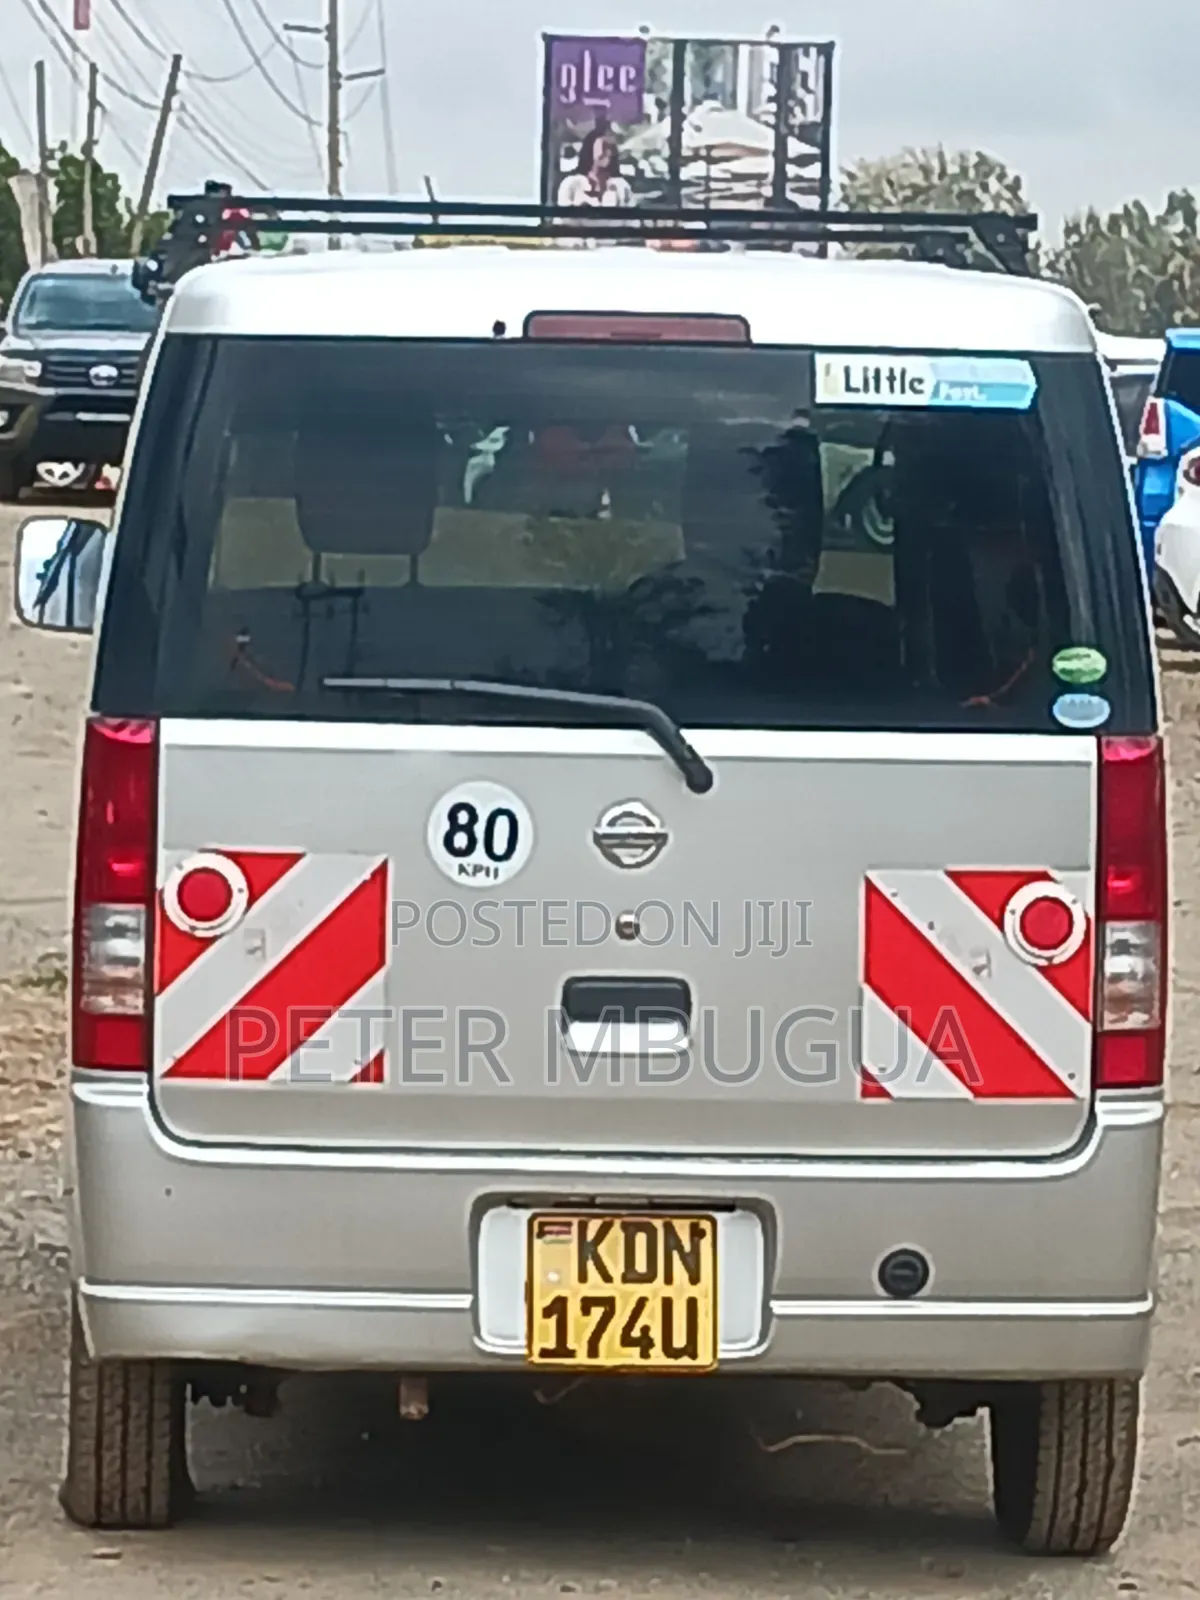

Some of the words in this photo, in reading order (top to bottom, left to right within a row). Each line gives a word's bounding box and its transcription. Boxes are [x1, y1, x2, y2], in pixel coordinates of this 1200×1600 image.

[560, 50, 637, 104] glee
[844, 365, 925, 394] Little
[443, 802, 519, 862] 80
[577, 1219, 705, 1286] KDN
[538, 1296, 699, 1360] 174U
